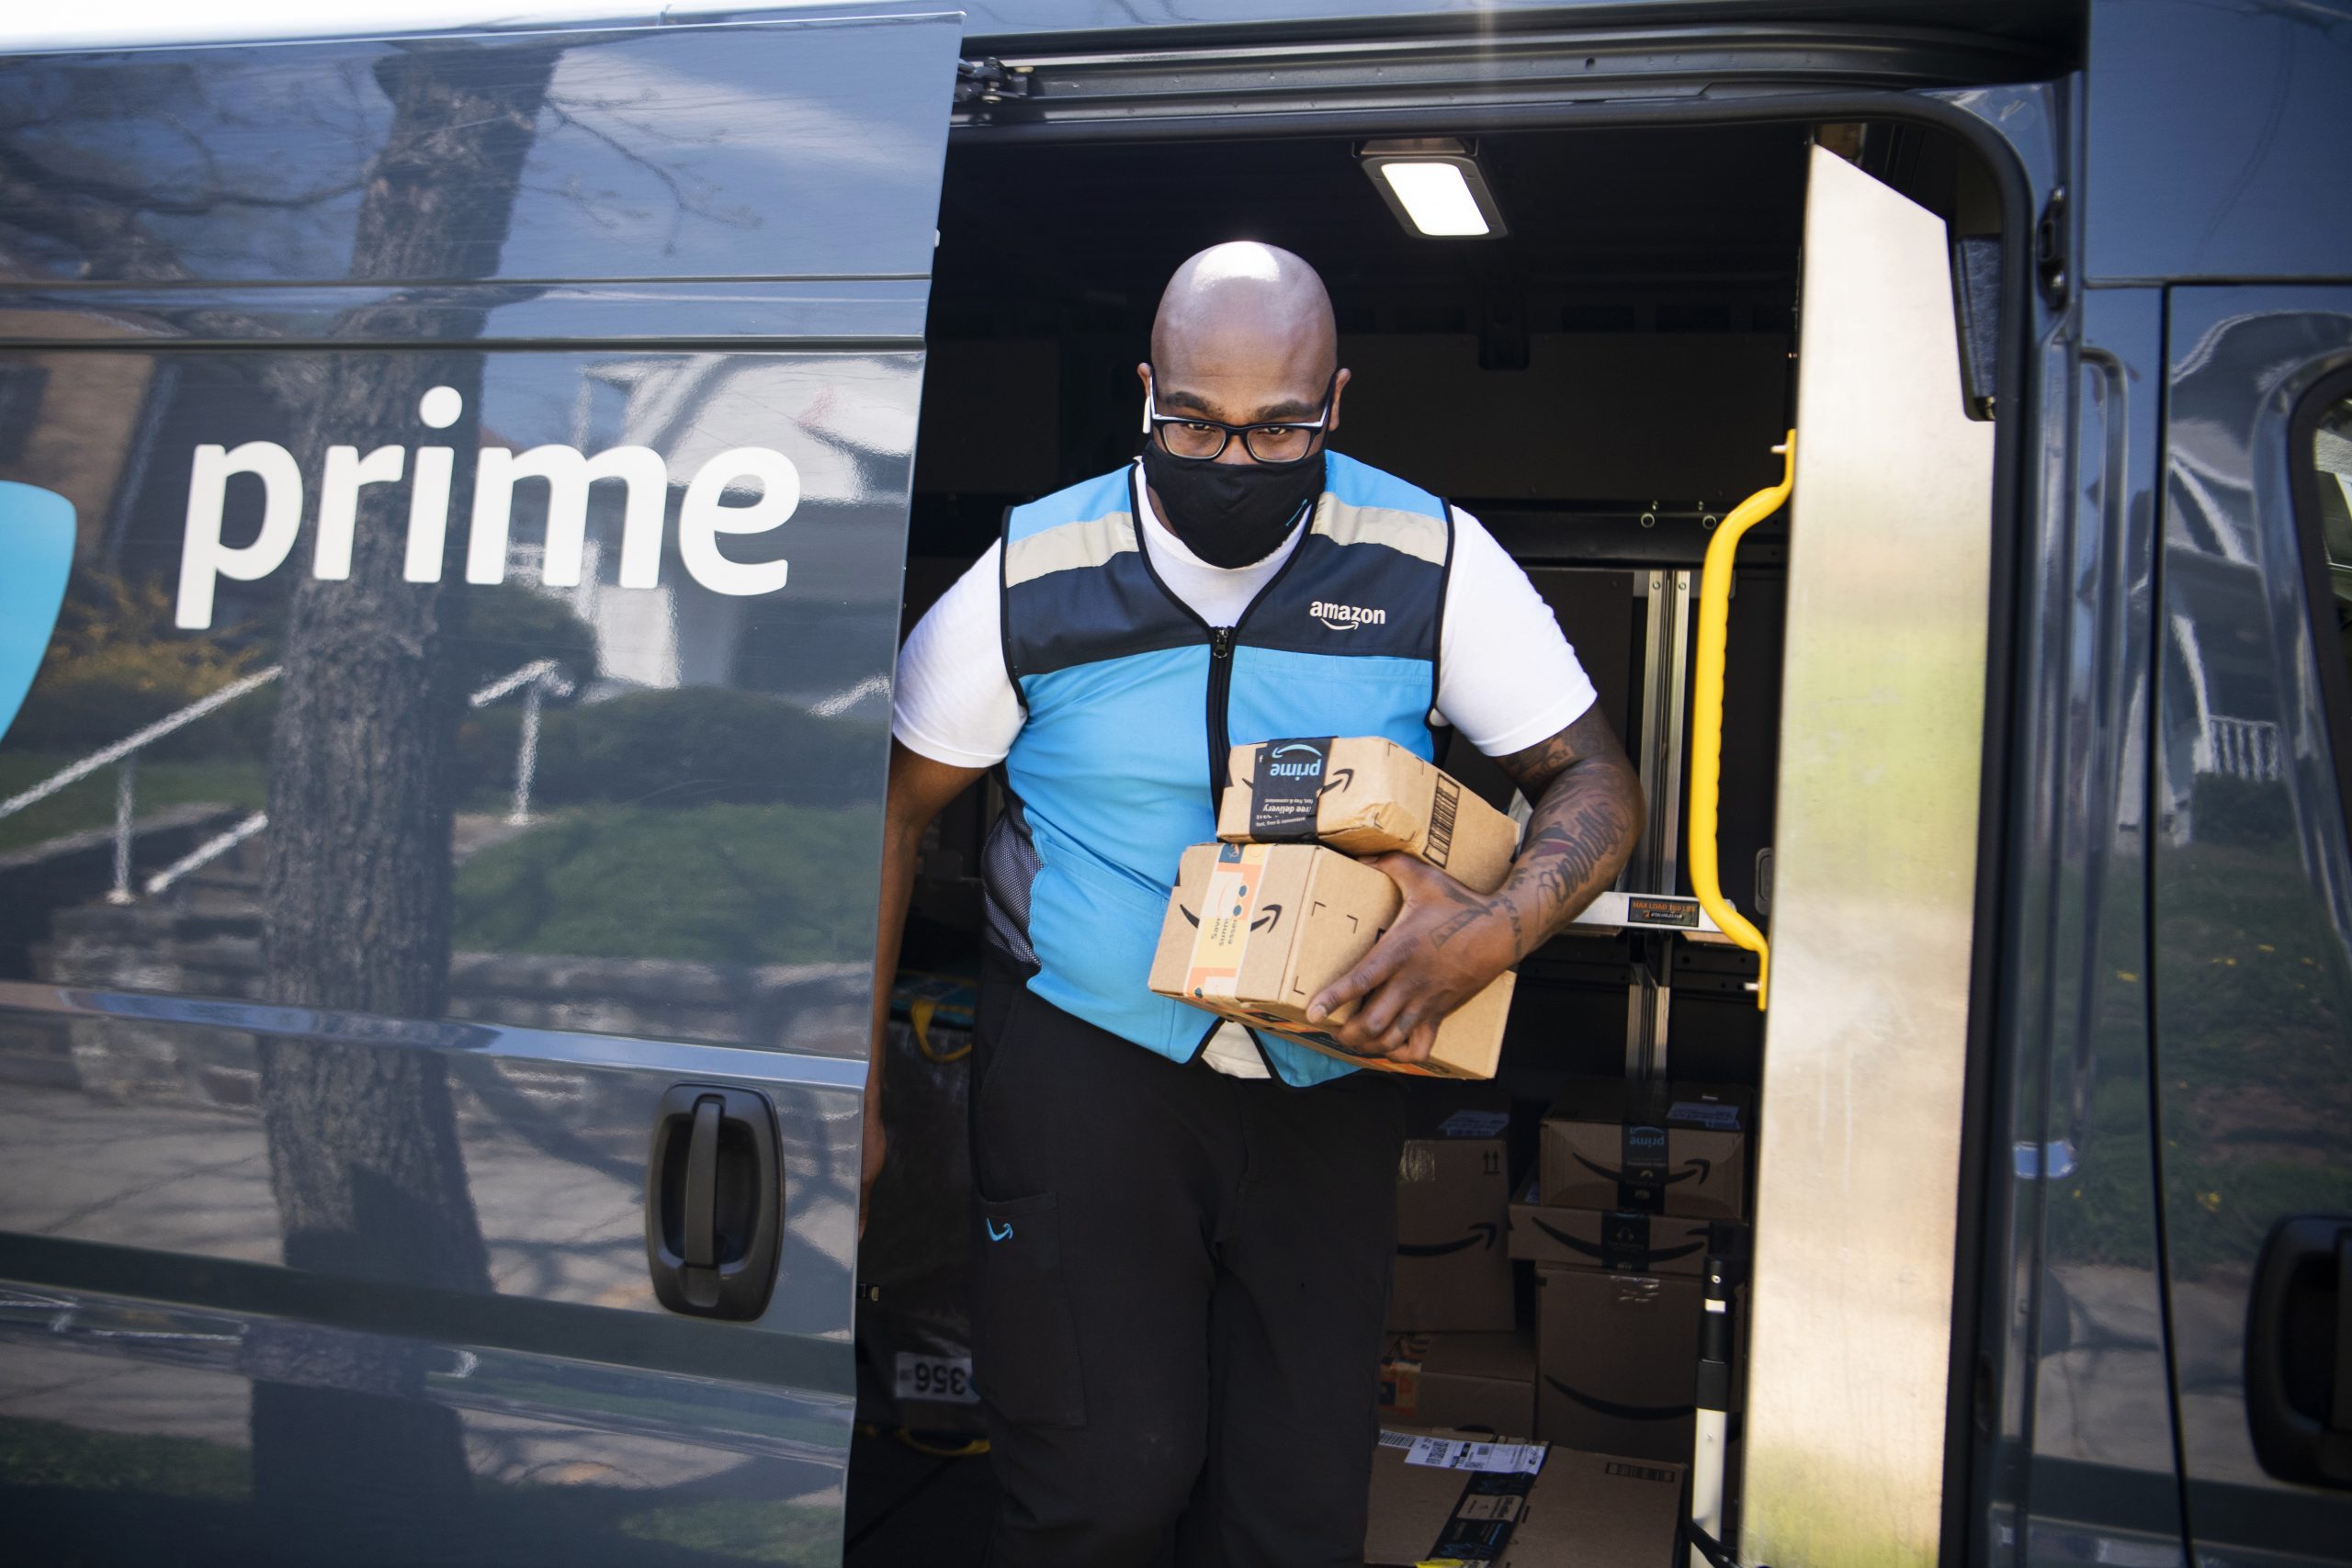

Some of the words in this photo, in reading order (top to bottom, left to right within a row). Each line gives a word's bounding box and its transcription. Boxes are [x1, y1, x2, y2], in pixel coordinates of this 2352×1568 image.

[175, 385, 801, 629] prime
[1309, 601, 1386, 625] amazon
[1270, 759, 1322, 781] prime
[1262, 804, 1295, 814] delivery
[1629, 1134, 1665, 1148] prime
[914, 1362, 967, 1395] 356
